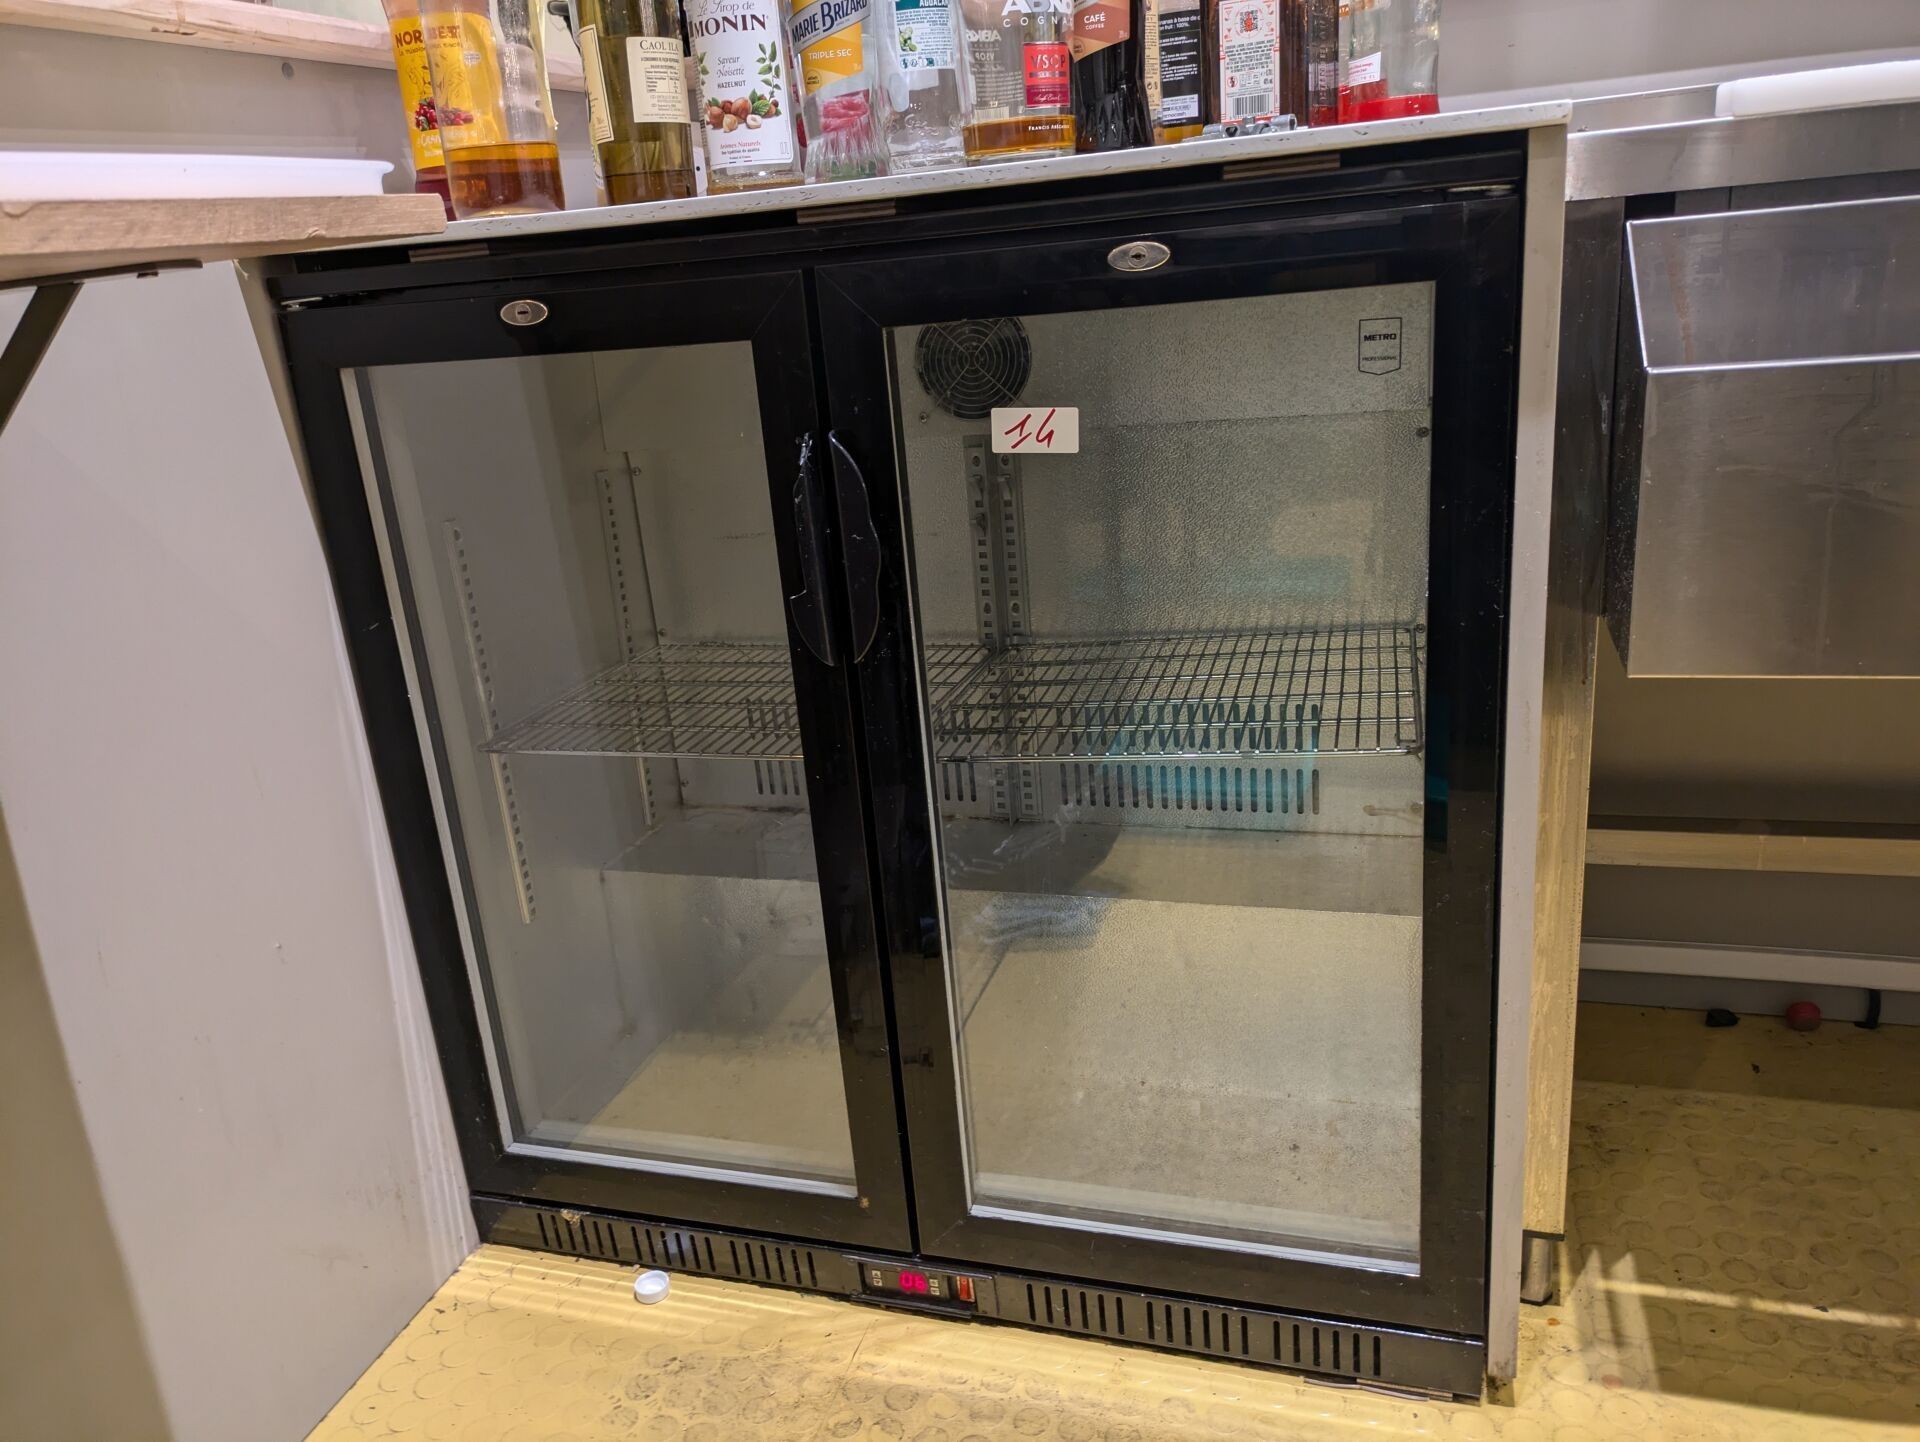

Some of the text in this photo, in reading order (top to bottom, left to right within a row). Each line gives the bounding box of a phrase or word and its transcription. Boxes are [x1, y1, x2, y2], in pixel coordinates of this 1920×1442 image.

[742, 1, 755, 10] de
[791, 12, 820, 43] MARIE
[820, 0, 868, 33] BRIZARD
[1084, 12, 1106, 24] CAFÉ
[688, 14, 766, 38] MONIN
[640, 39, 667, 51] CAOL
[808, 48, 852, 60] TRIPLE SEC
[717, 80, 746, 89] HAZELNUT
[1363, 333, 1397, 342] METRO
[1004, 408, 1056, 449] 14
